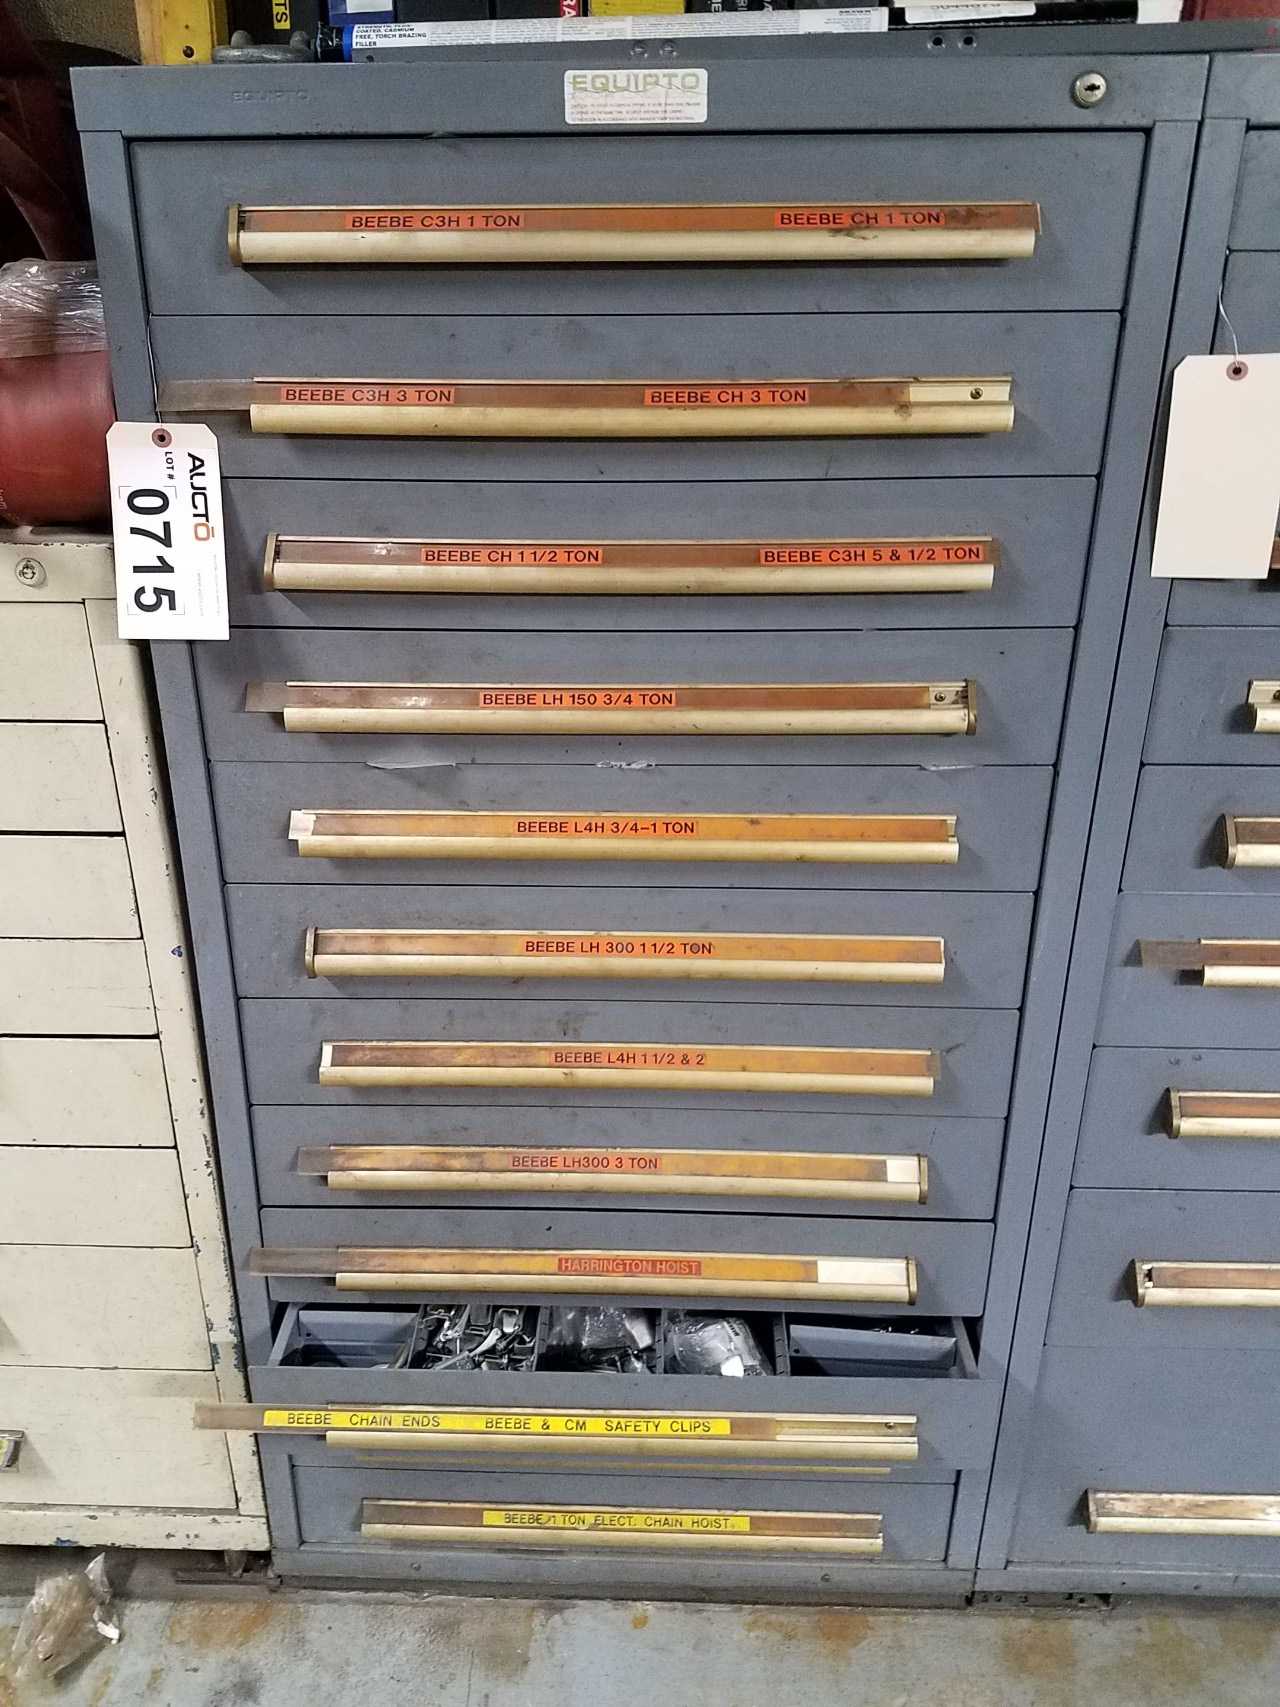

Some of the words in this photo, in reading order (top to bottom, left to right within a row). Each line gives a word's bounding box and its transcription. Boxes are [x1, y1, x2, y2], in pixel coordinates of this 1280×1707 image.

[571, 72, 700, 92] EQUIPTO
[351, 216, 414, 228] BEEBE
[420, 215, 460, 228] C3H
[467, 215, 475, 227] 1
[482, 215, 520, 227] TON
[780, 213, 843, 226] BEEBE
[851, 212, 879, 225] CH
[887, 212, 894, 224] 1
[903, 211, 941, 224] TON
[285, 389, 345, 401] BEEBE
[351, 389, 390, 402] C3H
[396, 389, 408, 402] 3
[414, 390, 451, 402] TON
[650, 390, 711, 403] BEEBE
[717, 390, 743, 403] CH
[750, 390, 761, 402] 3
[768, 390, 806, 402] TON
[164, 451, 175, 471] LOT
[127, 488, 177, 613] 0715
[425, 550, 482, 562] BEEBE
[487, 550, 512, 562] CH
[518, 550, 525, 562] 1
[530, 550, 558, 562] 1/2
[563, 550, 600, 562] TON
[764, 550, 822, 563] BEEBE
[828, 550, 865, 562] C3H
[872, 550, 883, 562] 5
[889, 550, 901, 561] &
[907, 549, 936, 561] 1/2
[942, 547, 980, 560] TON
[483, 693, 537, 705] BEEBE
[543, 693, 563, 705] LH
[568, 693, 597, 705] 150
[602, 693, 633, 705] 3/4
[639, 693, 673, 705] TON
[517, 821, 569, 833] BEEBE
[574, 821, 605, 833] L4H
[662, 822, 695, 834] TON
[525, 940, 575, 953] BEEBE
[580, 941, 600, 953] LH
[605, 941, 635, 954] 300
[639, 942, 646, 954] 1
[650, 942, 675, 954] 1/2
[680, 942, 713, 954] TON
[554, 1052, 602, 1063] BEEBE
[607, 1052, 637, 1064] L4H
[641, 1053, 648, 1064] 1
[652, 1053, 676, 1065] 1/2
[680, 1053, 690, 1065] &
[695, 1053, 705, 1065] 2
[511, 1155, 559, 1168] BEEBE
[563, 1156, 610, 1169] LH300
[614, 1157, 624, 1169] 3
[628, 1157, 658, 1169] TON
[561, 1258, 652, 1273] HARRINGTON
[656, 1261, 698, 1275] HOIST
[287, 1413, 332, 1425] BEEBE
[350, 1414, 392, 1427] CHAIN
[402, 1415, 441, 1428] ENDS
[484, 1417, 531, 1430] BEEBE
[541, 1418, 550, 1430] &
[564, 1419, 587, 1431] CM
[604, 1419, 661, 1433] SAFETY
[670, 1420, 711, 1433] CLIPS
[560, 1514, 585, 1526] TON
[644, 1516, 683, 1529] CHAIN
